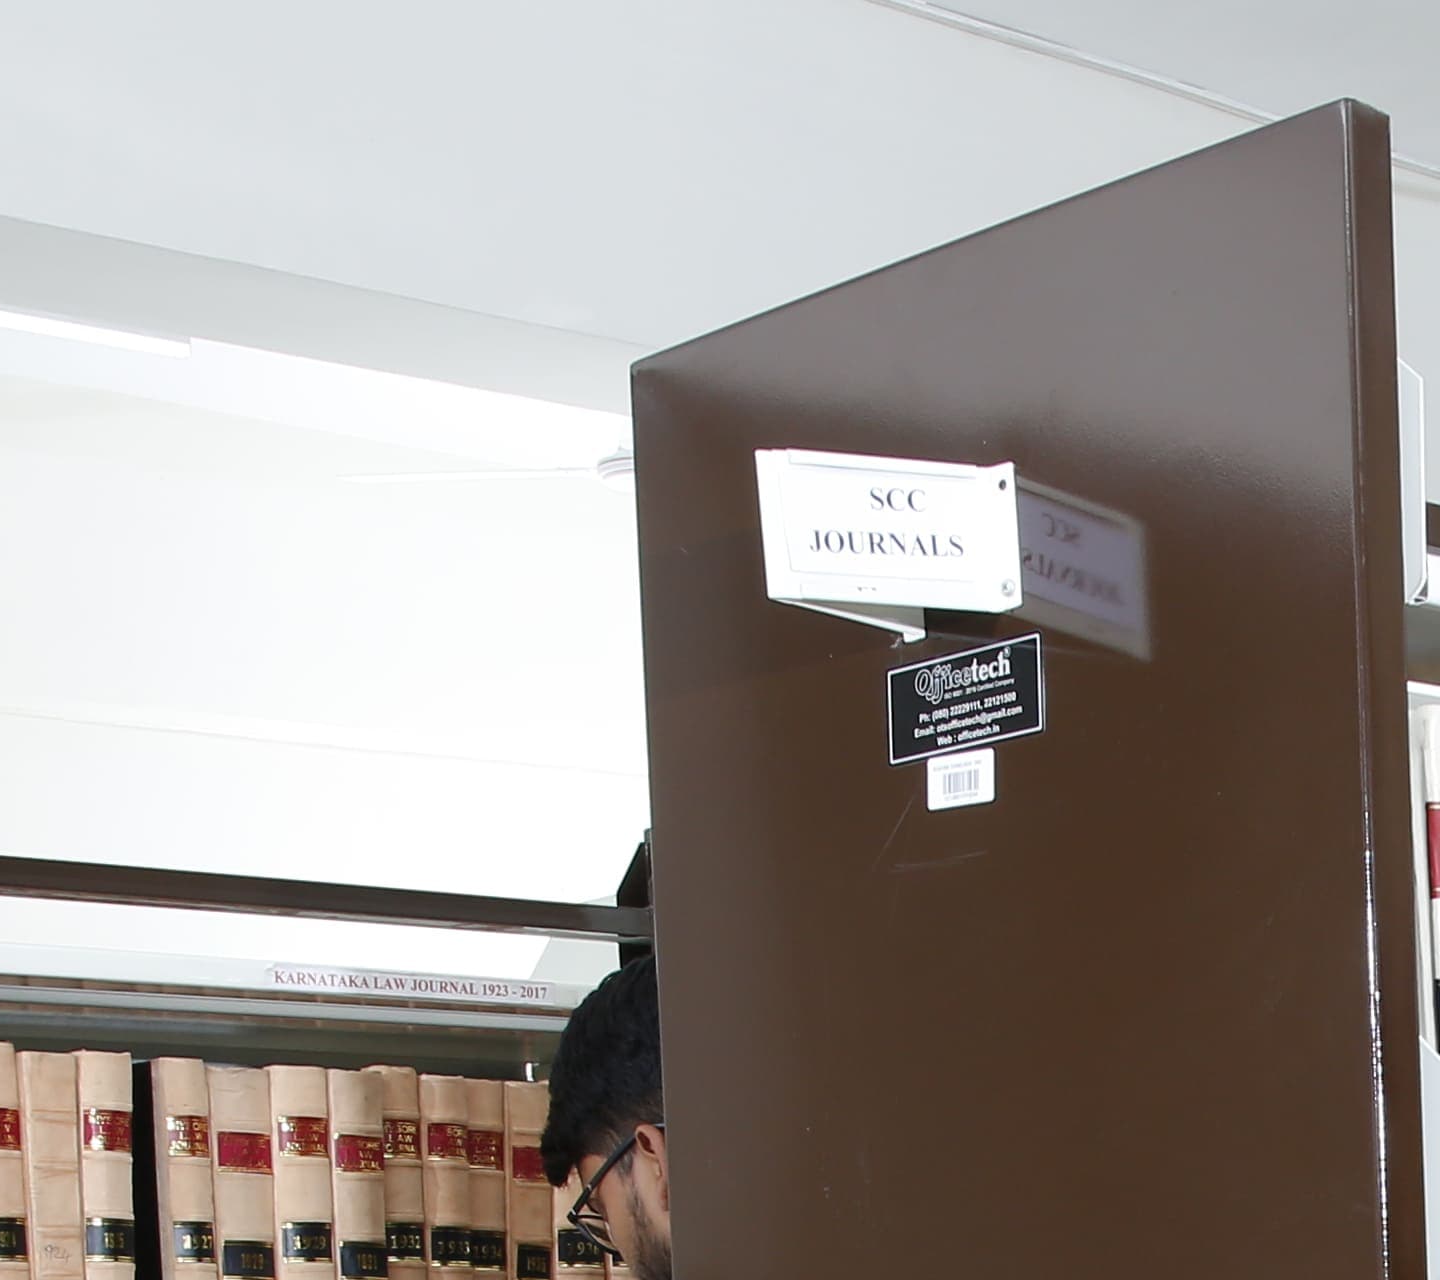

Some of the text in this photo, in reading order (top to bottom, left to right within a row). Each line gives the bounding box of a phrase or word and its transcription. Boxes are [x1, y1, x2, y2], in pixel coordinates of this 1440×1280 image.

[870, 487, 926, 512] SCC
[810, 530, 964, 557] JOURNALS
[275, 970, 369, 989] KARNATAKA
[374, 976, 407, 991] LAW
[410, 980, 478, 995] JOURNAL
[482, 983, 509, 997] 1923
[520, 986, 547, 999] 2017
